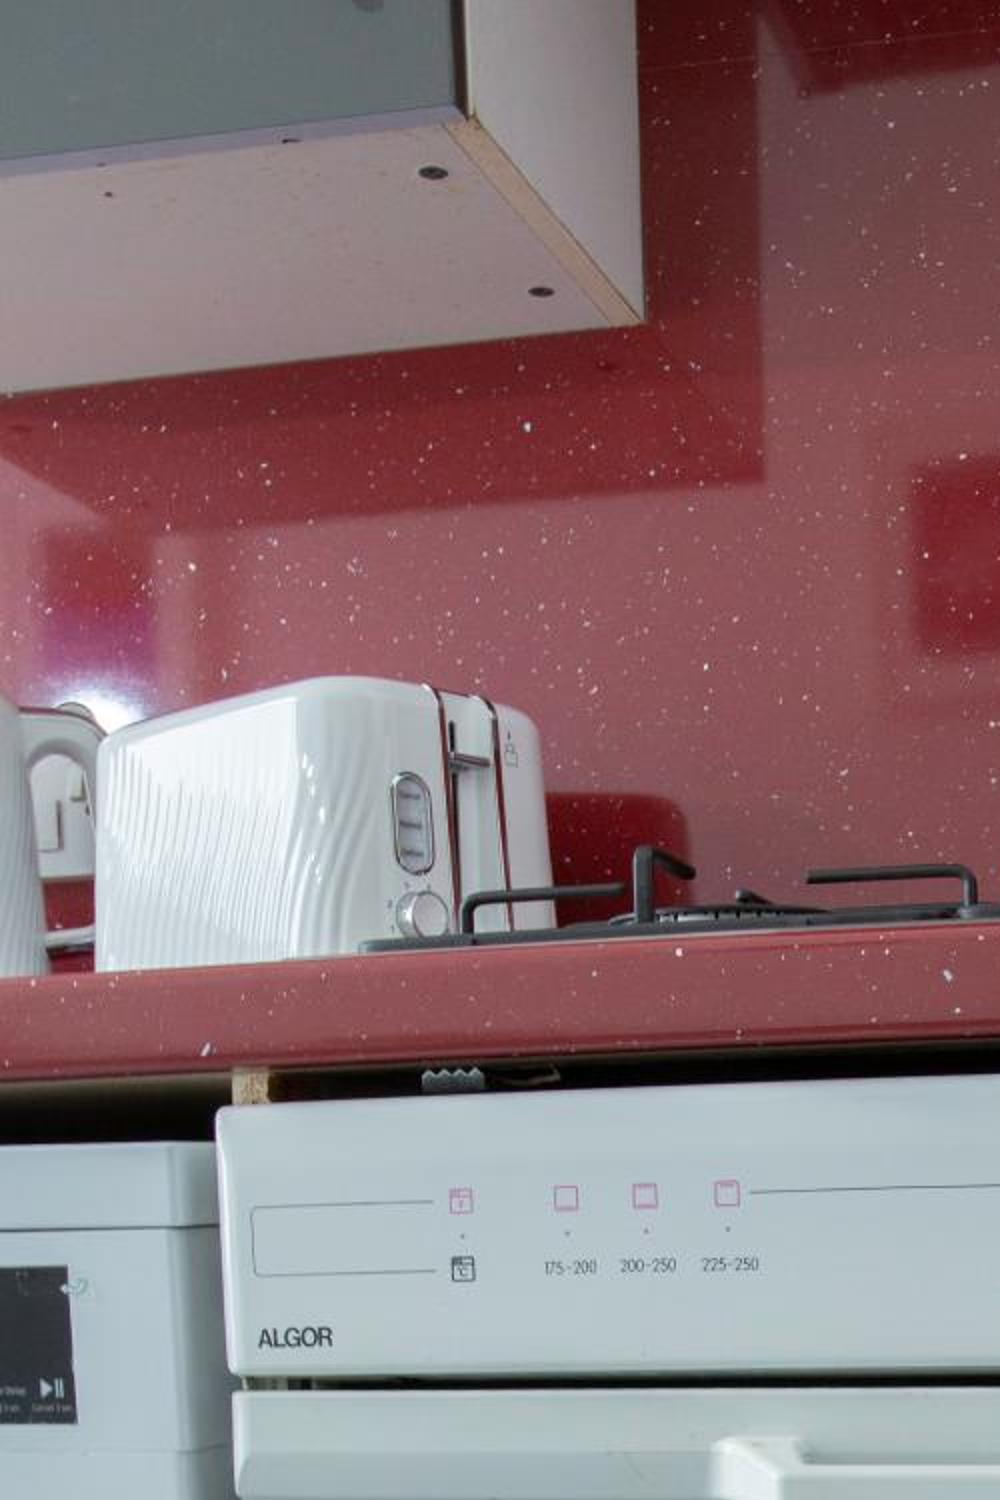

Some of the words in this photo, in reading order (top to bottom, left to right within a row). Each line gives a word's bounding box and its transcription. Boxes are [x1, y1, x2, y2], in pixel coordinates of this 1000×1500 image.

[544, 1259, 598, 1276] 175-200
[619, 1257, 677, 1274] 200-250
[702, 1256, 760, 1273] 225-250
[258, 1326, 334, 1349] ALGOR
